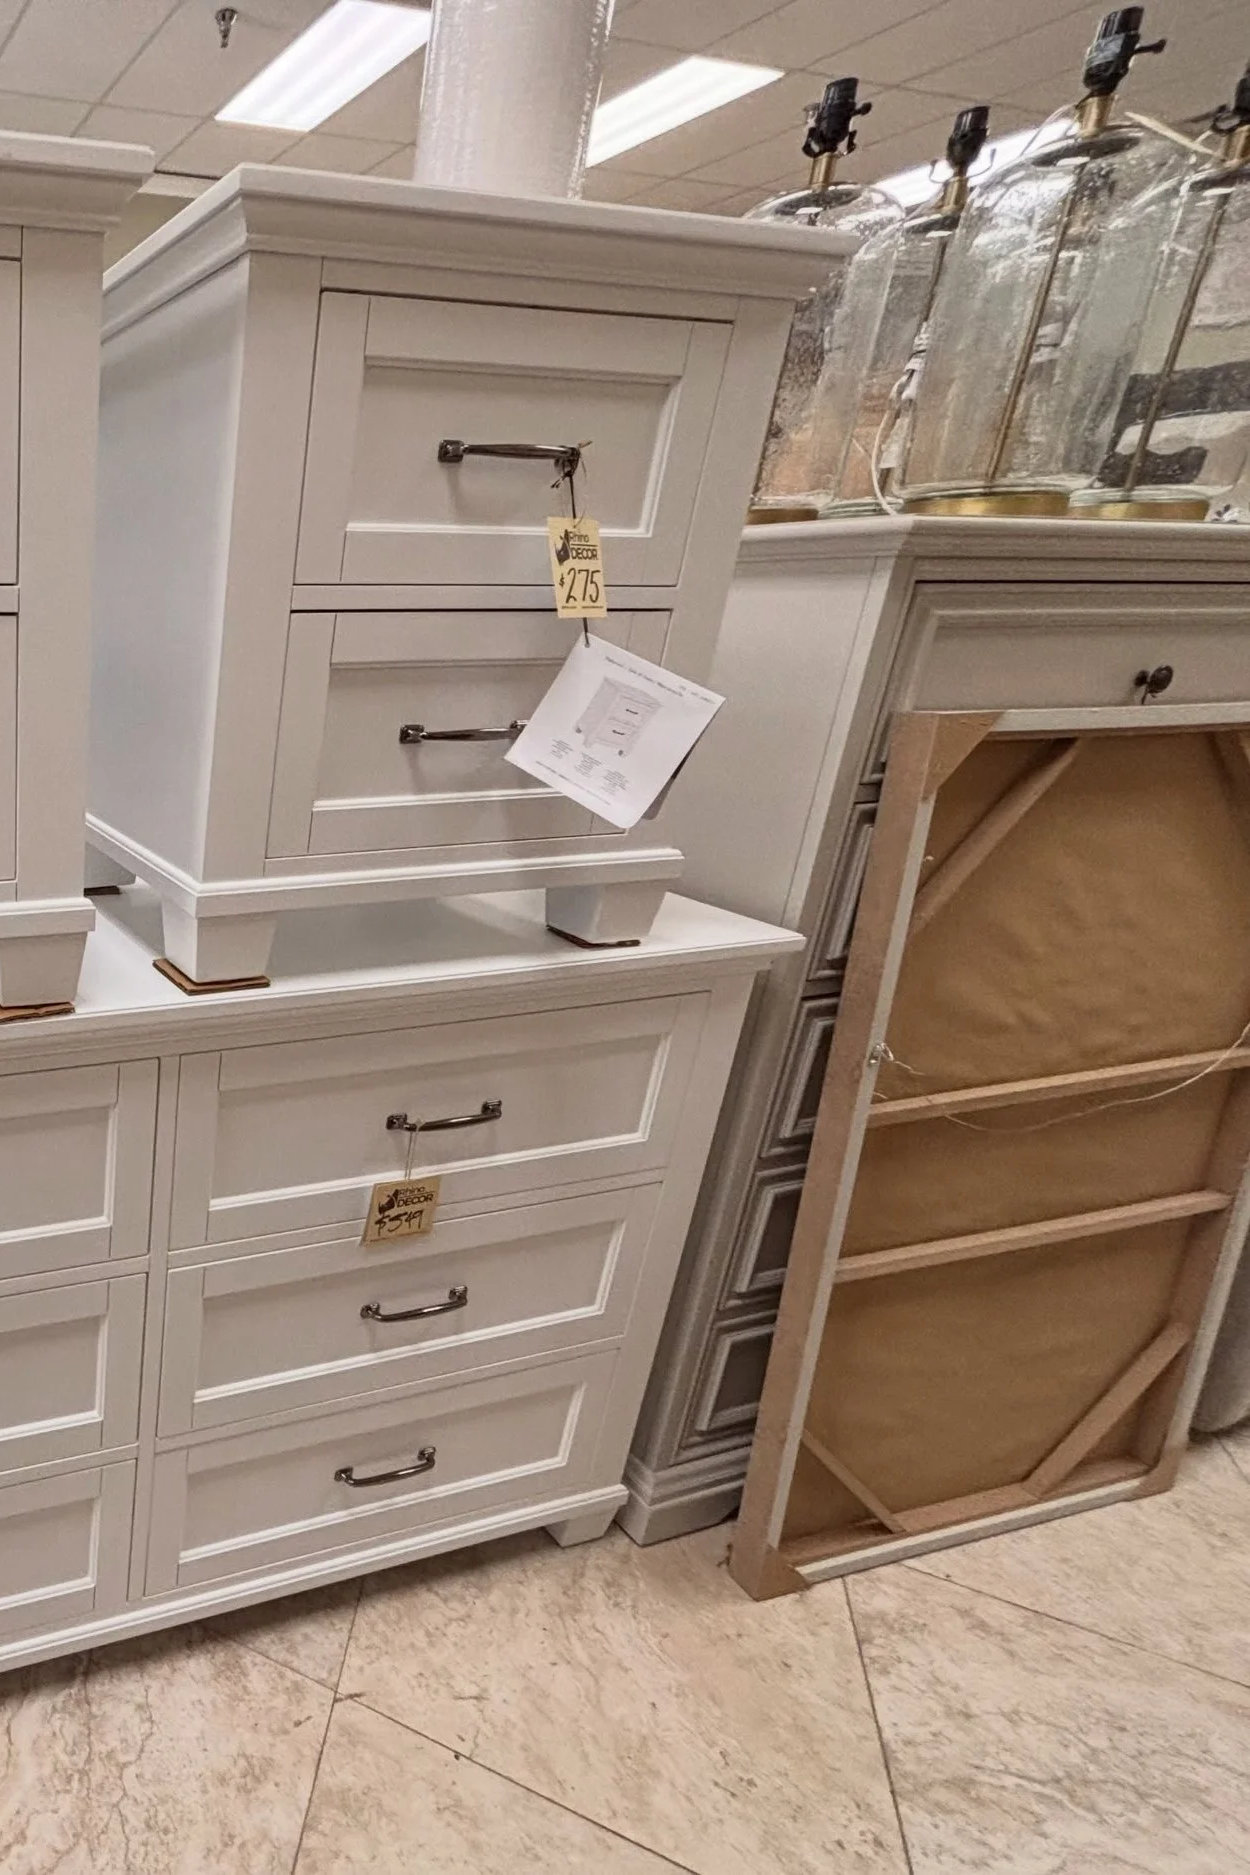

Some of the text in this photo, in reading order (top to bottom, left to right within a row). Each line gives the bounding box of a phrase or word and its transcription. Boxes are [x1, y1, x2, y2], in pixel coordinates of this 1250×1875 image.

[569, 531, 590, 543] Rhino
[570, 547, 598, 560] DECOR
[397, 1194, 434, 1208] DECOR
